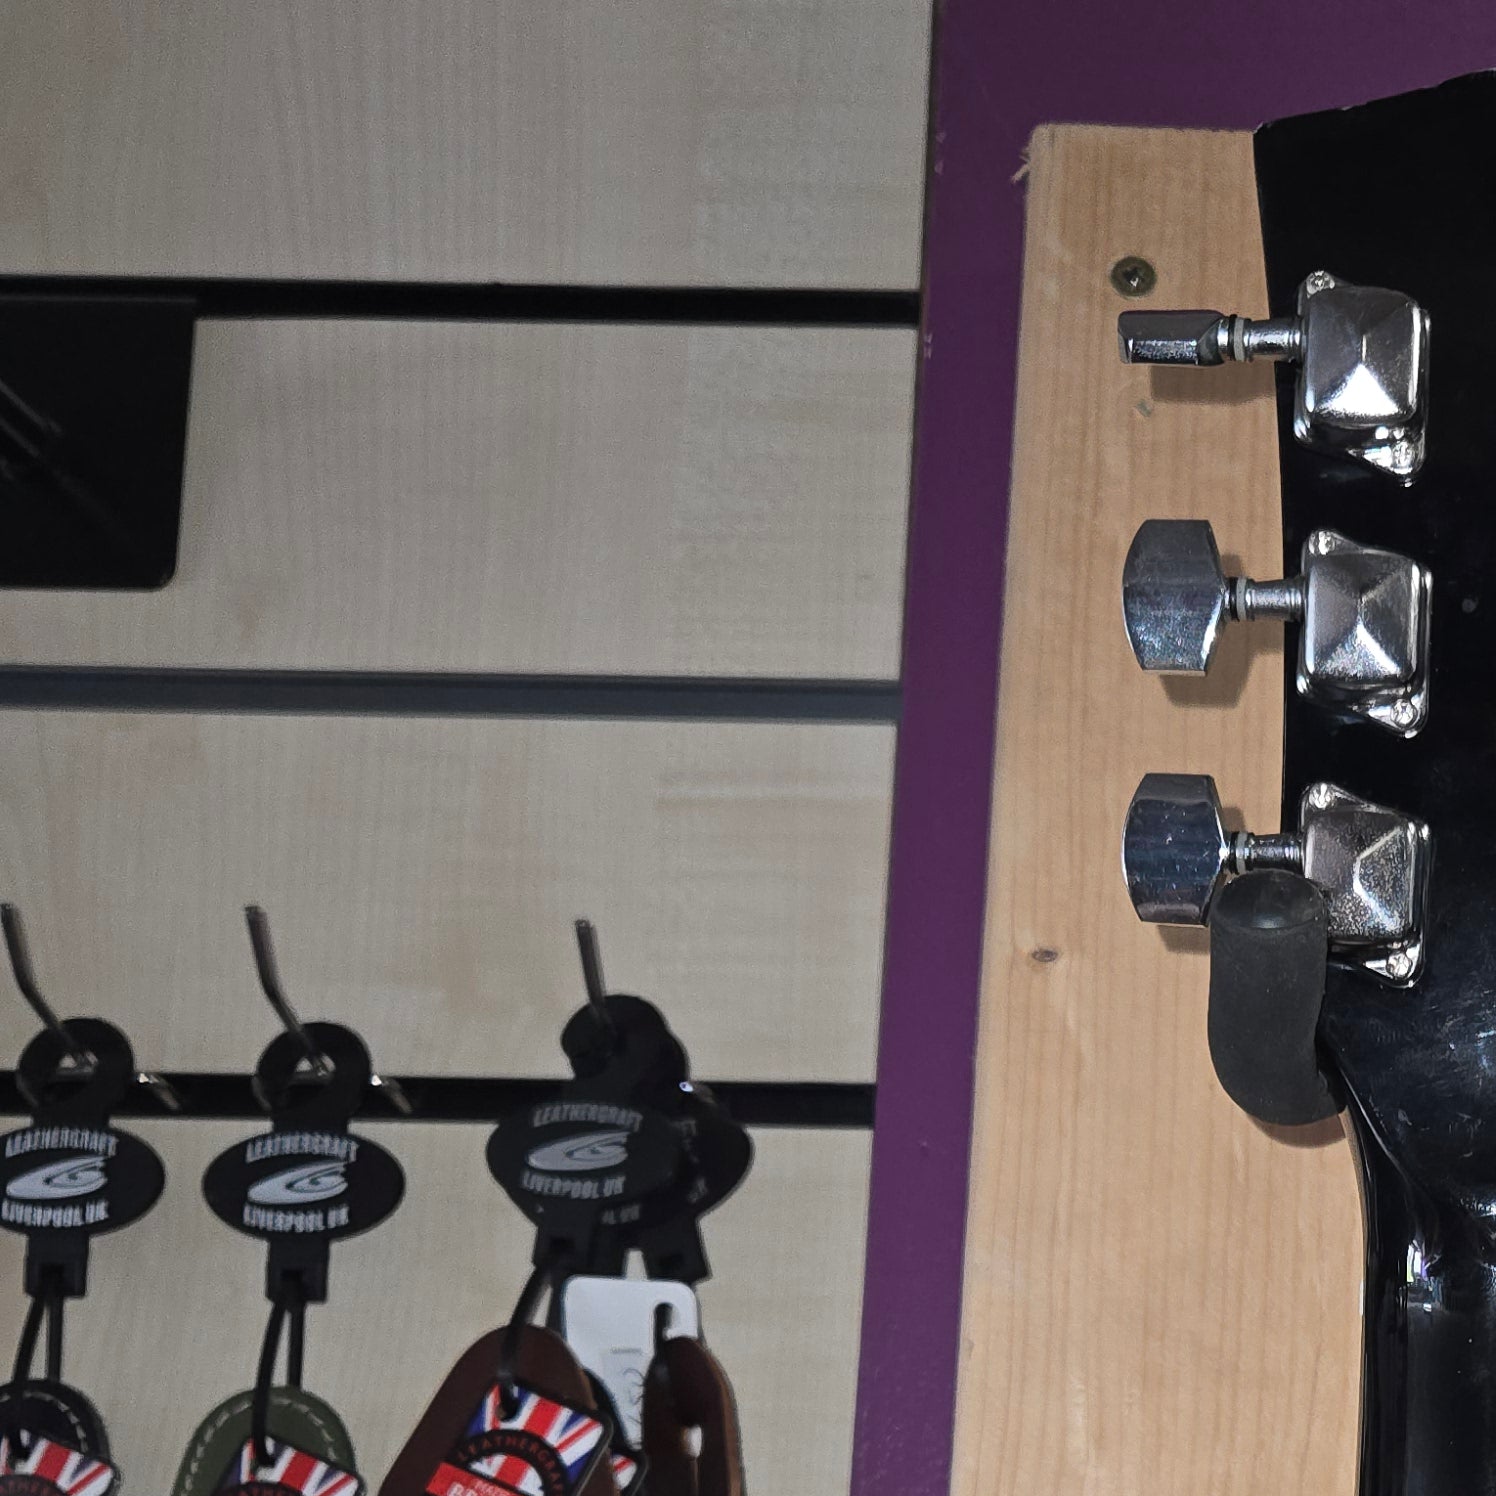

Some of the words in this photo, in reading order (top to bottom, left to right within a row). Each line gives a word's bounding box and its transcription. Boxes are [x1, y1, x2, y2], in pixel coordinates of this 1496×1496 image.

[533, 1103, 643, 1132] LEATHERCRAFT
[5, 1127, 119, 1159] LEATHERCRAFT
[246, 1132, 359, 1163] LEATHERCRAFT
[522, 1170, 599, 1199] LIVERPOOL
[603, 1175, 626, 1197] UK
[2, 1199, 85, 1227] LIVERPOOL
[87, 1200, 109, 1223] UK
[244, 1202, 325, 1232] LIVERPOOL
[328, 1204, 350, 1230] UK
